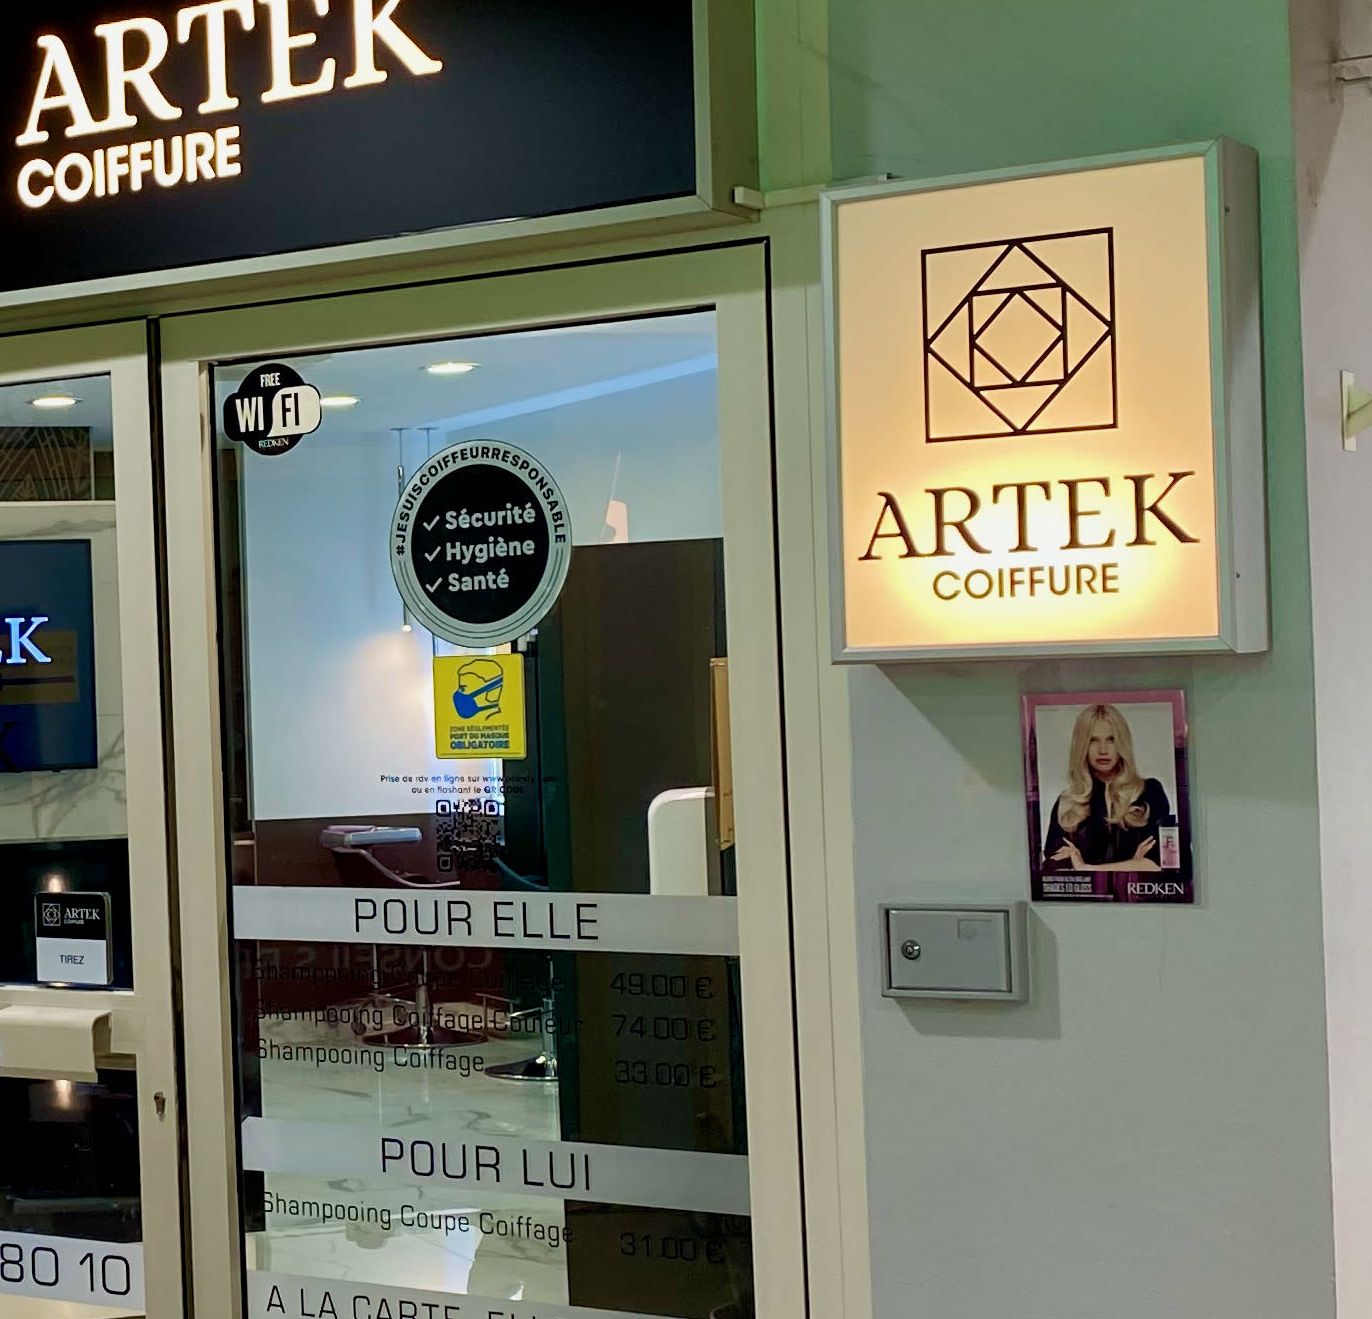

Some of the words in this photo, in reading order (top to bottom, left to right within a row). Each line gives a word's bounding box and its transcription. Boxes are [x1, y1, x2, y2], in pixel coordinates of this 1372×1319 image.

[17, 125, 241, 209] COIFFURE
[260, 373, 280, 387] FREE
[259, 437, 289, 448] REDKEN
[396, 446, 566, 555] #JESUISCOIFFEURRESPONSABLE
[445, 502, 536, 530] Sécurité
[859, 470, 1200, 562] ARTEK
[446, 536, 536, 564] Hygiène
[448, 568, 509, 592] Santé
[932, 561, 1120, 602] COIFFURE
[451, 740, 510, 749] OBLIGATOIRE
[444, 775, 465, 784] ligne
[484, 786, 496, 794] QR
[1128, 882, 1184, 894] REDKEN
[64, 908, 100, 920] ARTEK
[354, 898, 473, 937] POUR
[494, 901, 600, 941] ELLE
[60, 954, 84, 965] TIREZ
[256, 1000, 384, 1030] Shampooing
[257, 1040, 384, 1072] Shampooing
[394, 1046, 485, 1075] Coiffage
[381, 1137, 501, 1183] POUR
[523, 1148, 590, 1192] LUI
[262, 1191, 391, 1230] Shampooing
[400, 1205, 470, 1236] Coupe
[479, 1212, 574, 1245] Coiffage
[0, 1243, 59, 1287] 80
[79, 1252, 130, 1296] 10
[266, 1285, 285, 1315] A
